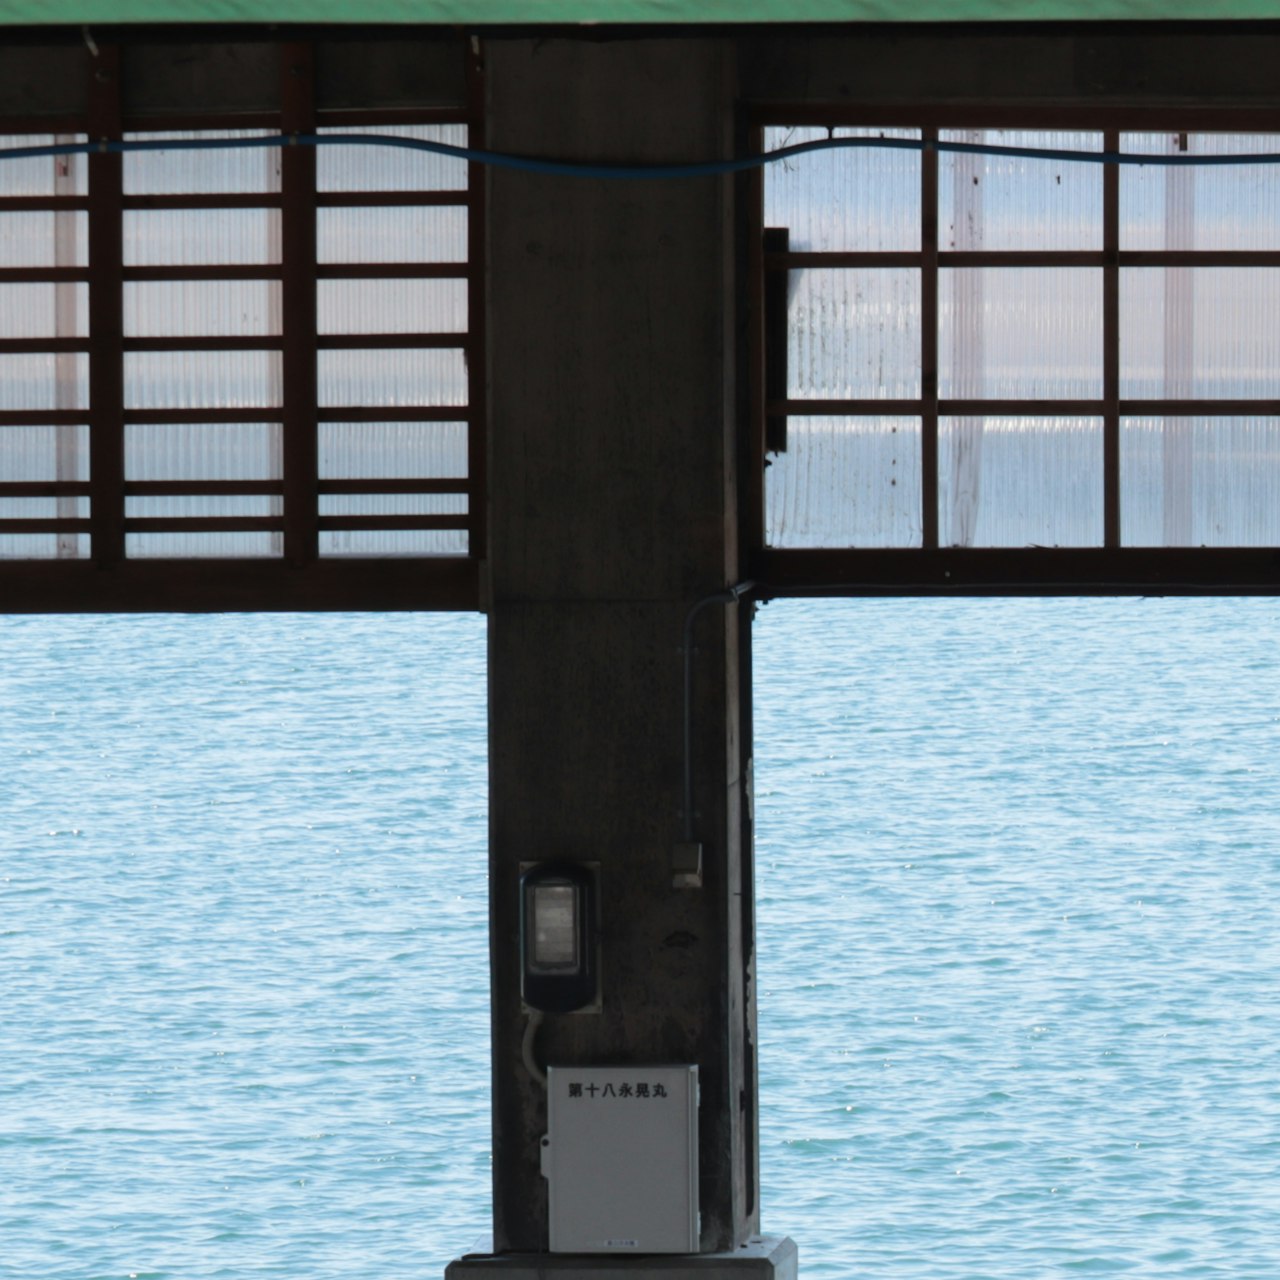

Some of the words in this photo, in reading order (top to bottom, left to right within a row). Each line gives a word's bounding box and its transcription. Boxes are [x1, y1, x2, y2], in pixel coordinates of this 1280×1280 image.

[569, 1083, 667, 1098] 第十八永晃丸
